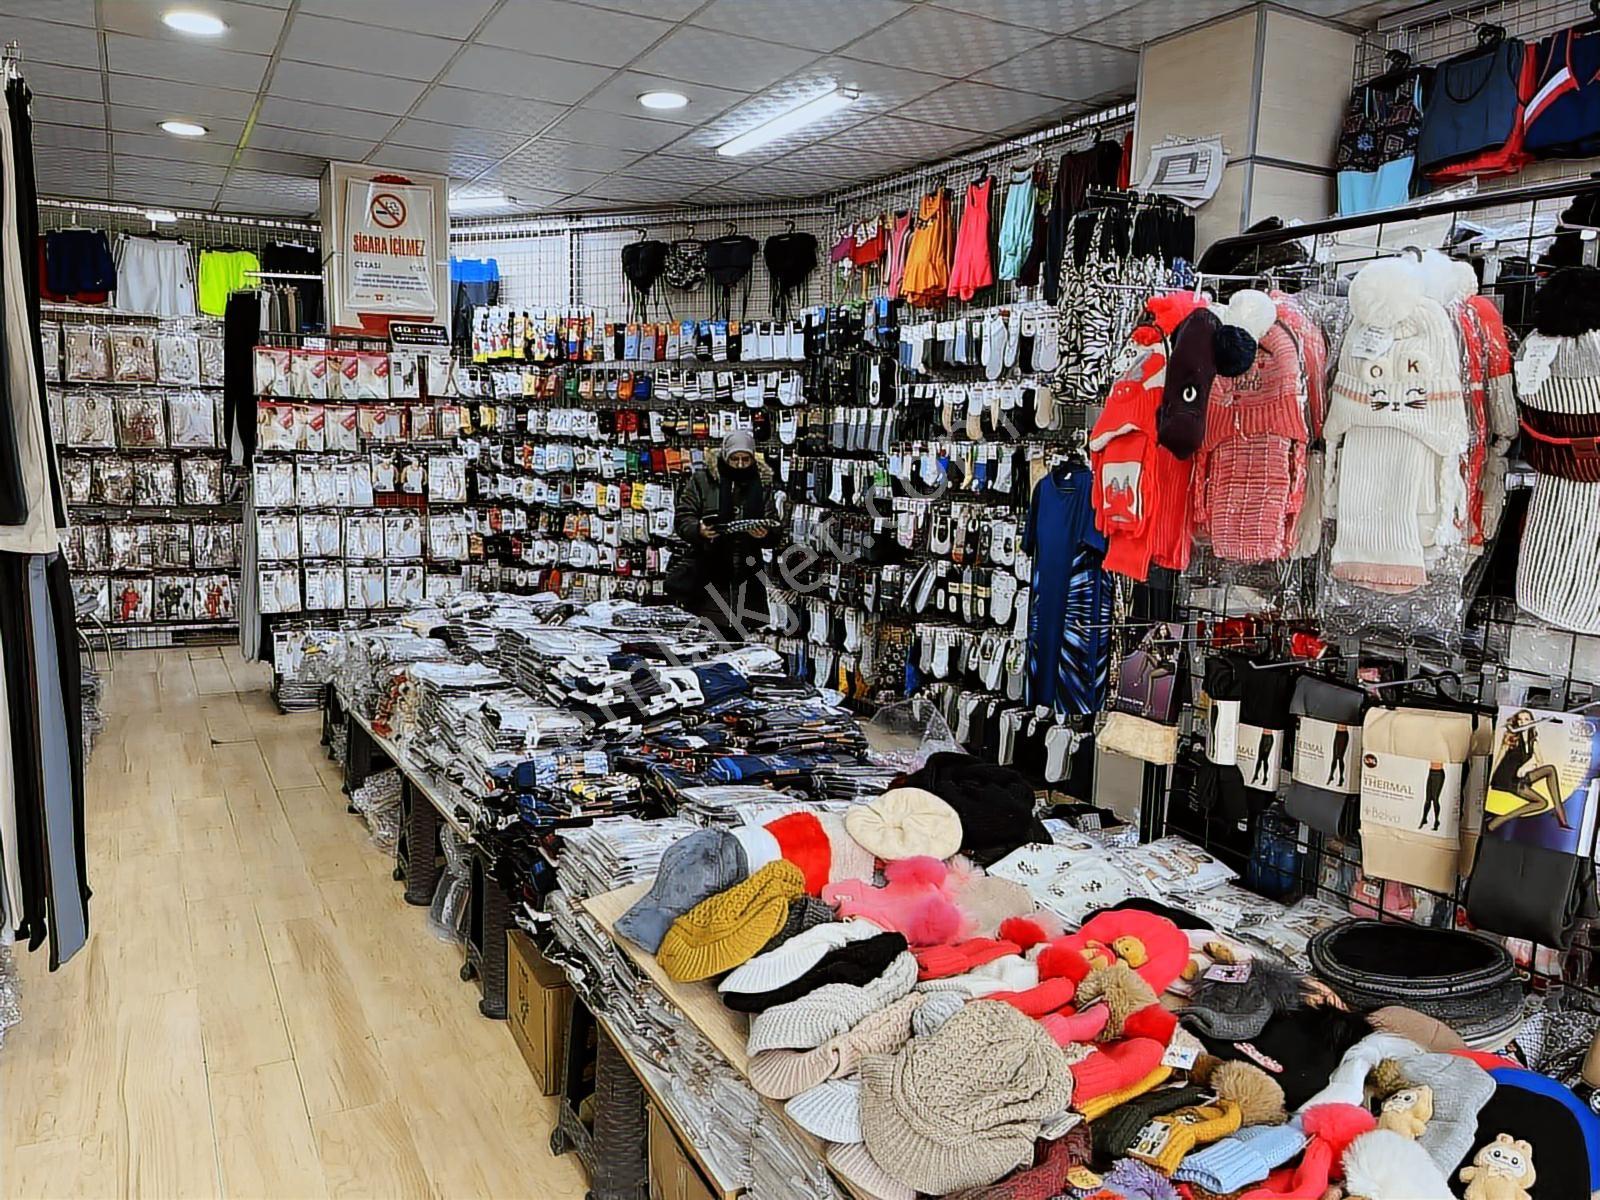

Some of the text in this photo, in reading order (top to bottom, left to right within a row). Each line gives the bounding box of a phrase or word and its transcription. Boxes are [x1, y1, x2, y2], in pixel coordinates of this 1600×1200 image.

[353, 232, 426, 258] SİGARA İÇİLMEZ
[1407, 358, 1419, 373] K
[1363, 775, 1415, 796] THERMAL
